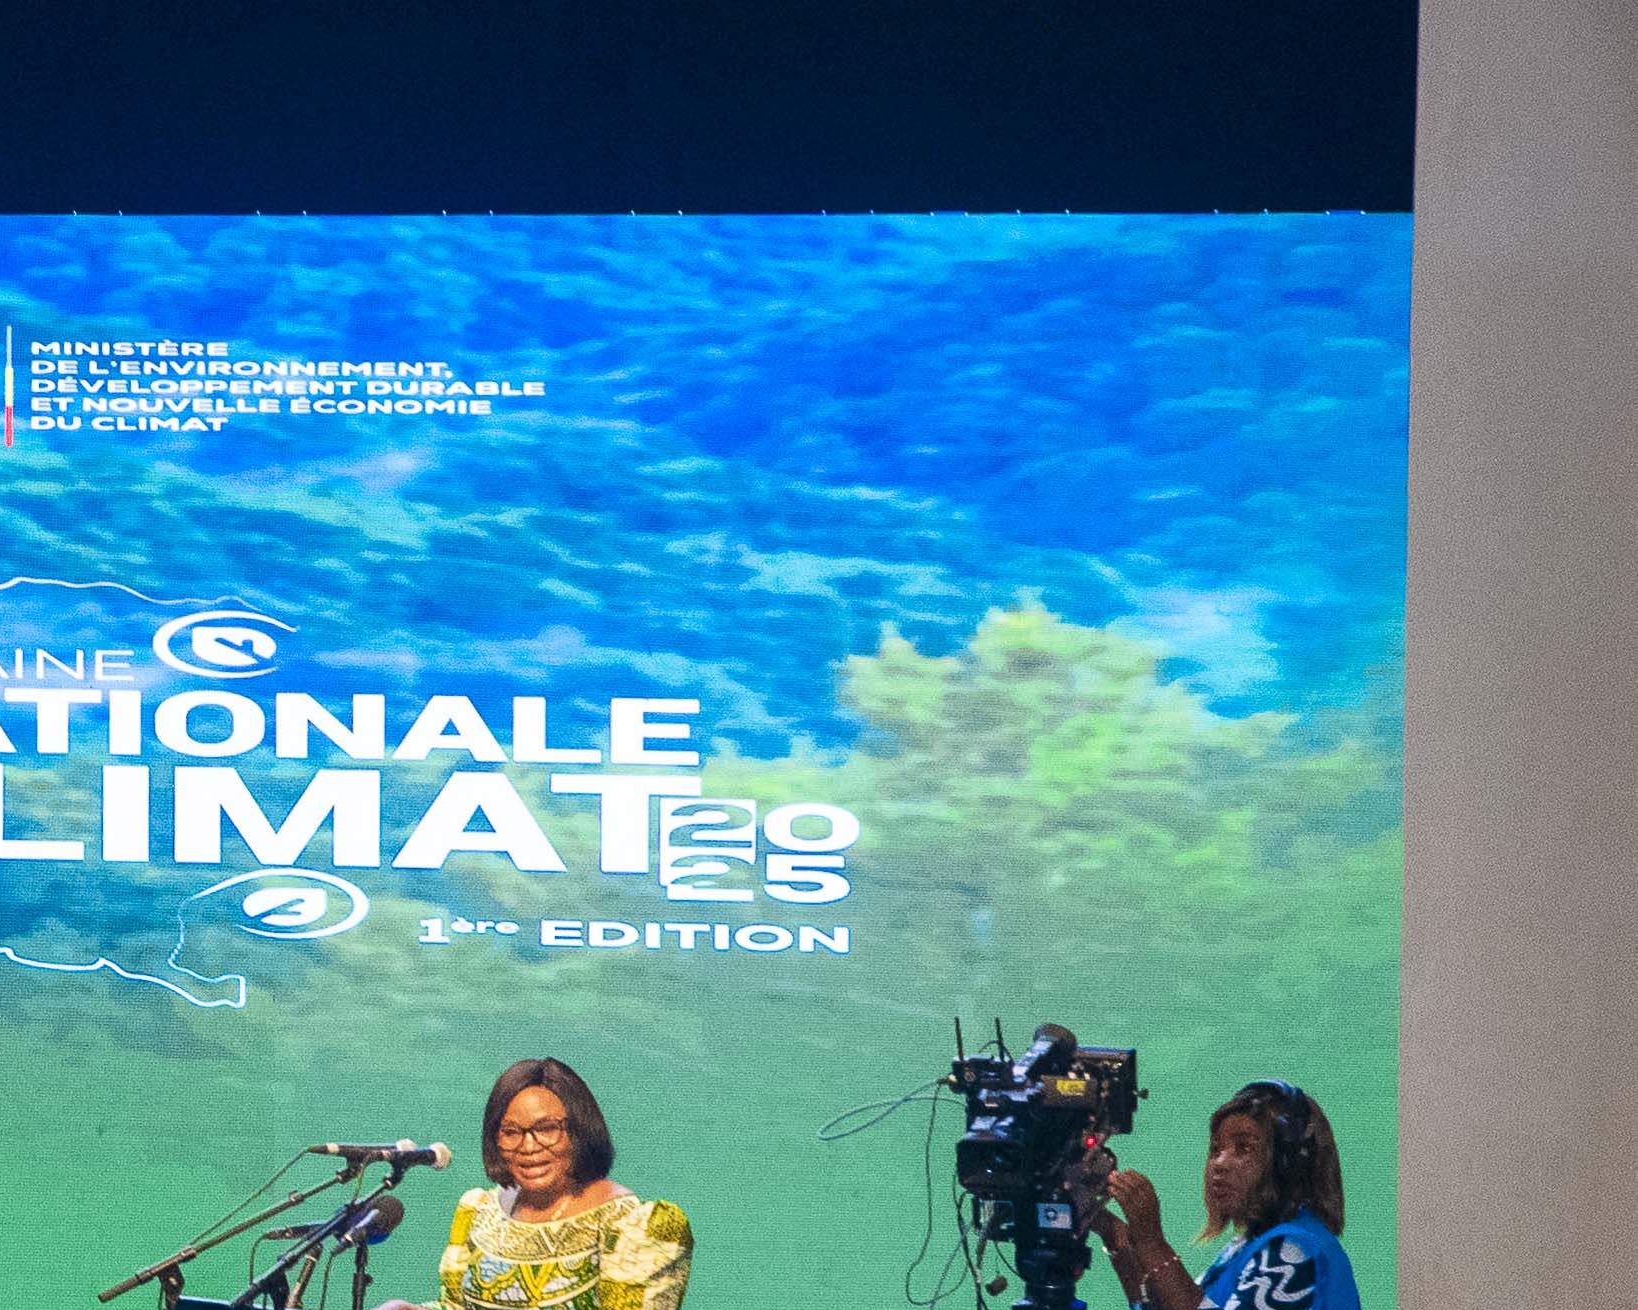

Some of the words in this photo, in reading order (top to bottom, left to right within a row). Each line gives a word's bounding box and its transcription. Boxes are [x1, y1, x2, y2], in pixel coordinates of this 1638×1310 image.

[30, 339, 229, 357] MINISTÈRE
[30, 360, 79, 375] DE
[30, 376, 359, 396] DÉVELOPPEMENT
[366, 380, 546, 396] DURABLE
[30, 397, 75, 412] ET
[82, 398, 281, 414] NOUVELLE
[289, 397, 492, 416] ÉCONOMIE
[30, 416, 83, 431] DU
[91, 417, 228, 432] CLIMAT
[419, 917, 520, 944] 1ère
[539, 918, 851, 955] EDITION
